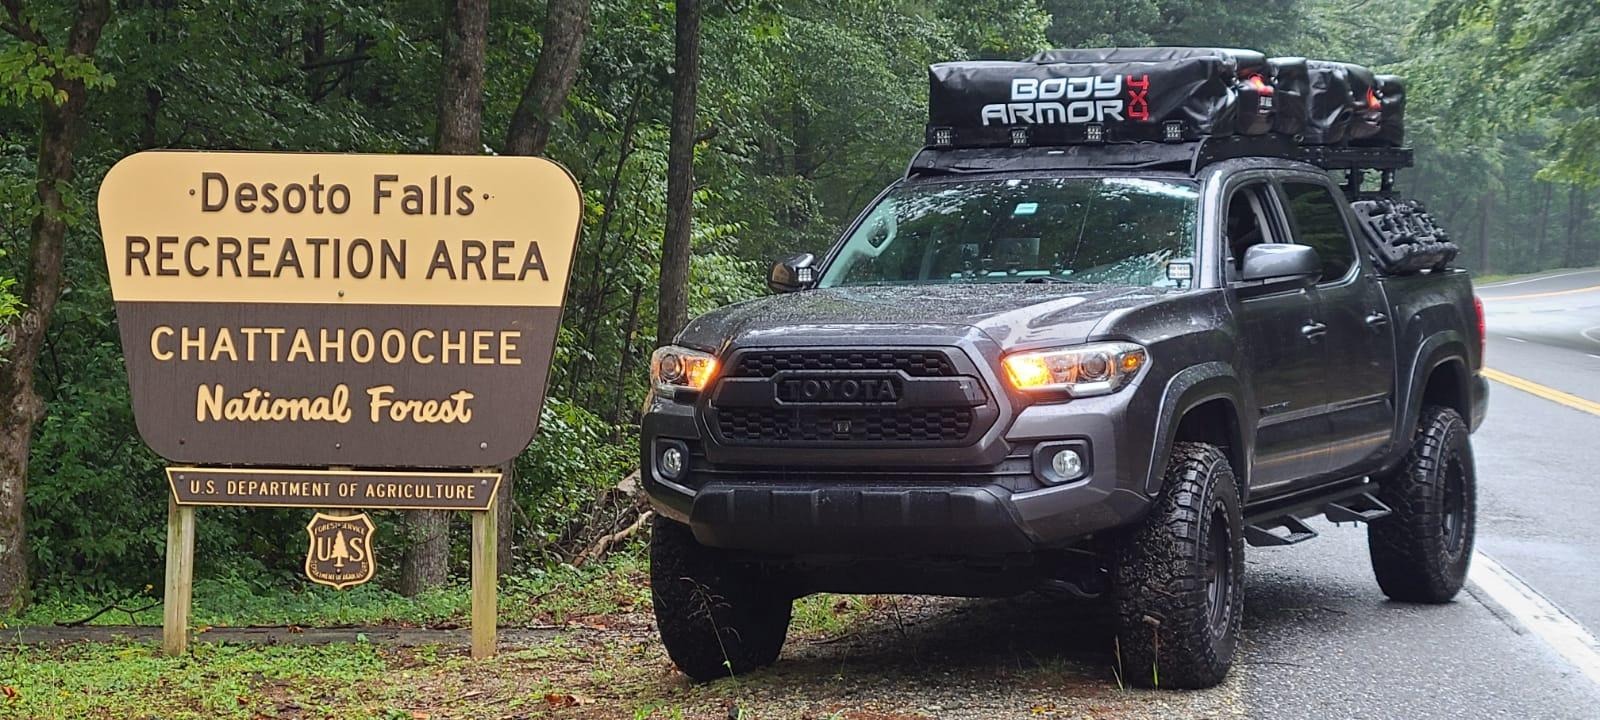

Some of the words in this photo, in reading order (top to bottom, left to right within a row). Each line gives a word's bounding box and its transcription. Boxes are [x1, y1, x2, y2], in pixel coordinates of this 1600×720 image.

[1011, 74, 1123, 100] BODY
[981, 100, 1125, 126] ARMOR
[201, 172, 351, 215] Desoto
[373, 174, 475, 216] Falls
[125, 236, 407, 280] RECREATION
[425, 239, 549, 282] AREA
[150, 326, 522, 365] CHATTAHOOCHEE
[196, 384, 351, 424] National
[366, 385, 474, 424] Forest
[784, 379, 897, 400] TOYOTA
[190, 480, 219, 495] U.S.
[227, 481, 331, 497] DEPARTMENT
[339, 483, 358, 498] OF
[366, 484, 476, 499] AGRICULTURE
